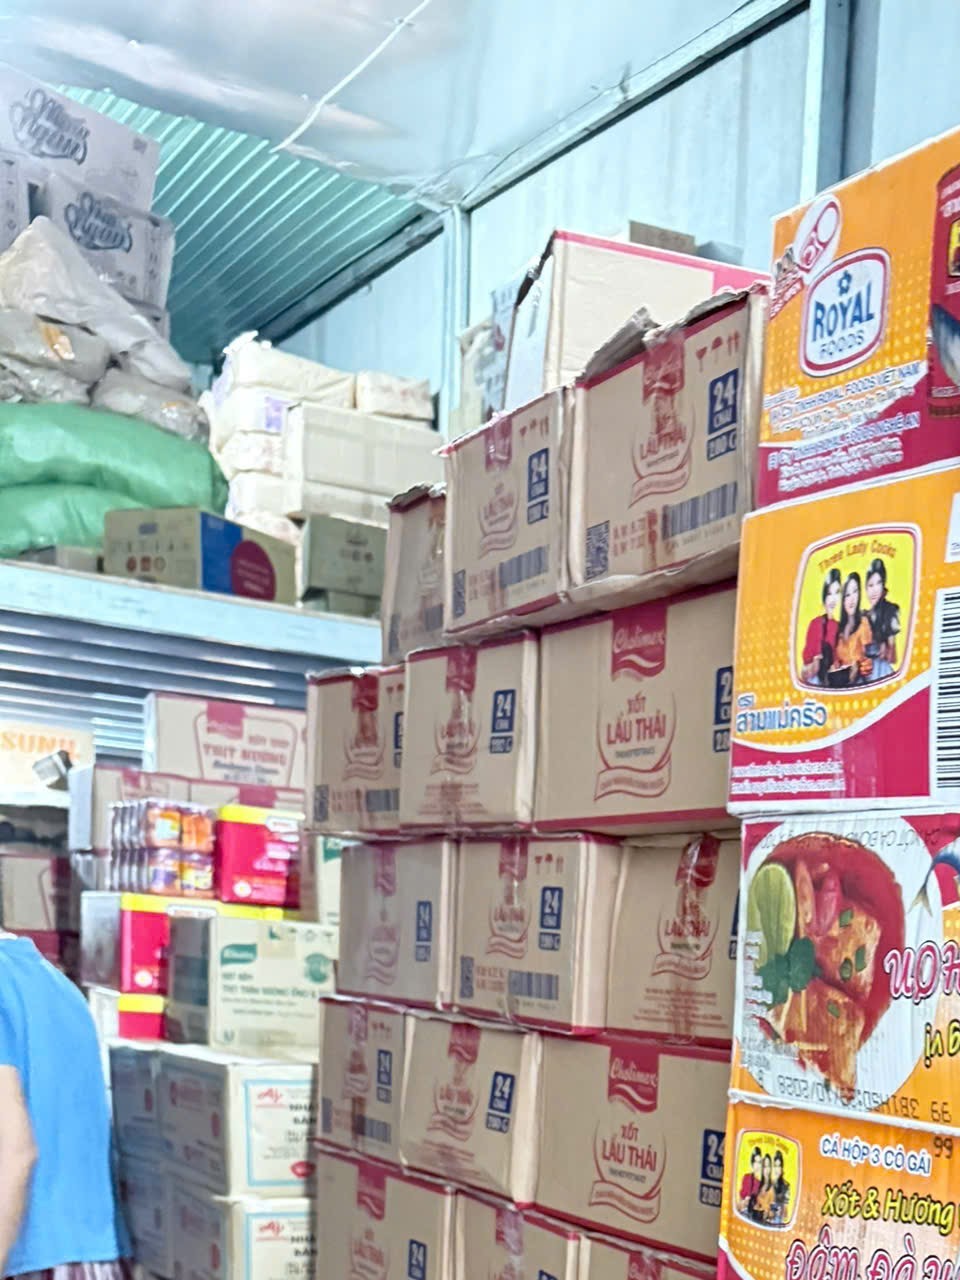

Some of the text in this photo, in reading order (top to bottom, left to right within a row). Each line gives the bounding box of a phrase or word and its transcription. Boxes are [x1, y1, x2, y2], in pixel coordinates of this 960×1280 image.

[812, 282, 874, 340] ROYAL
[820, 330, 865, 359] FOODS
[713, 375, 736, 405] 24
[496, 693, 513, 719] 24
[736, 703, 827, 733] สามแม่ครัว
[542, 889, 559, 913] 24
[924, 1023, 941, 1068] vị
[495, 1076, 510, 1098] 24
[610, 1057, 659, 1088] Cholimex
[929, 1102, 952, 1123] 99
[820, 1134, 931, 1176] CÁ HỘP 3 CÔ GÁI
[933, 1136, 953, 1159] 99
[822, 1180, 860, 1219] Xốt
[862, 1189, 881, 1219] &
[883, 1189, 955, 1236] Hương
